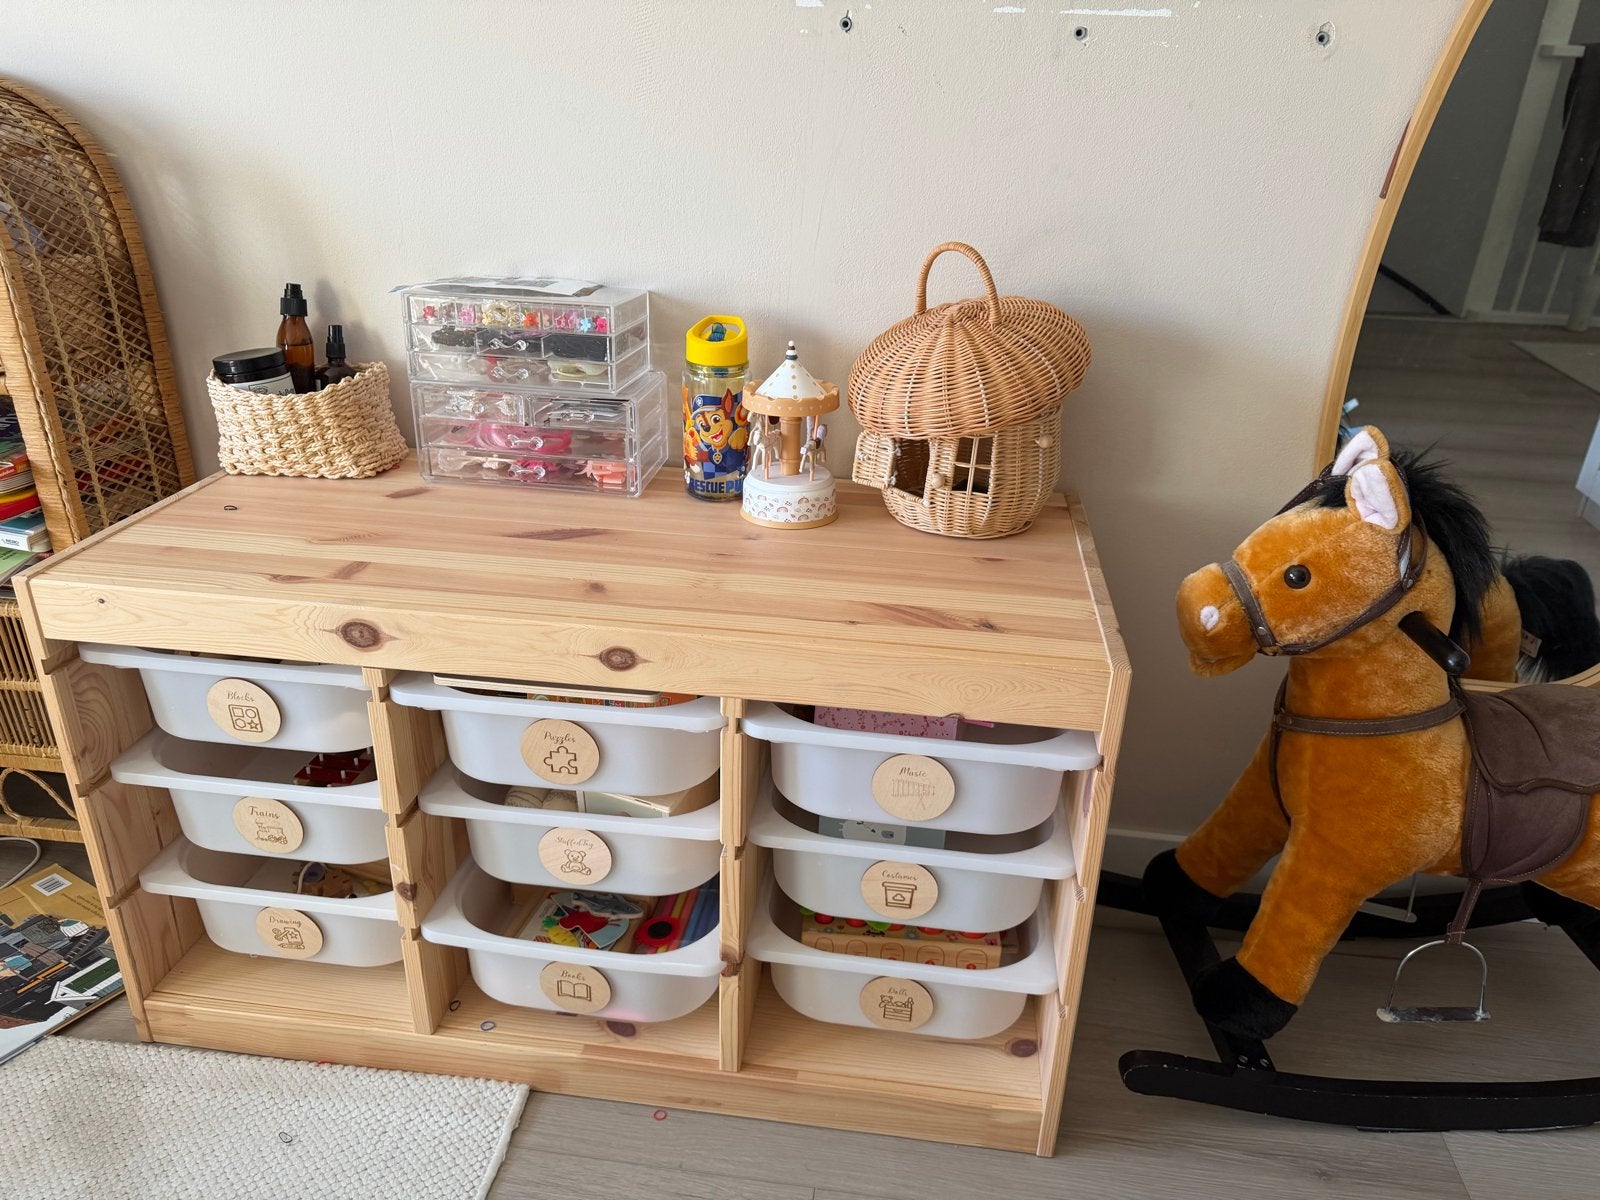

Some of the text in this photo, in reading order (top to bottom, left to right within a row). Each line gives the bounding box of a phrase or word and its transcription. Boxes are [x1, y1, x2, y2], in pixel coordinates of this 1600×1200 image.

[726, 478, 742, 493] PU
[226, 690, 255, 702] Blocks
[544, 731, 576, 744] Puzzles
[899, 766, 928, 778] Music
[248, 805, 281, 820] Trains
[881, 869, 918, 881] Costumes
[269, 915, 302, 928] Drawing
[560, 969, 586, 981] Books
[887, 986, 908, 997] Dolls
